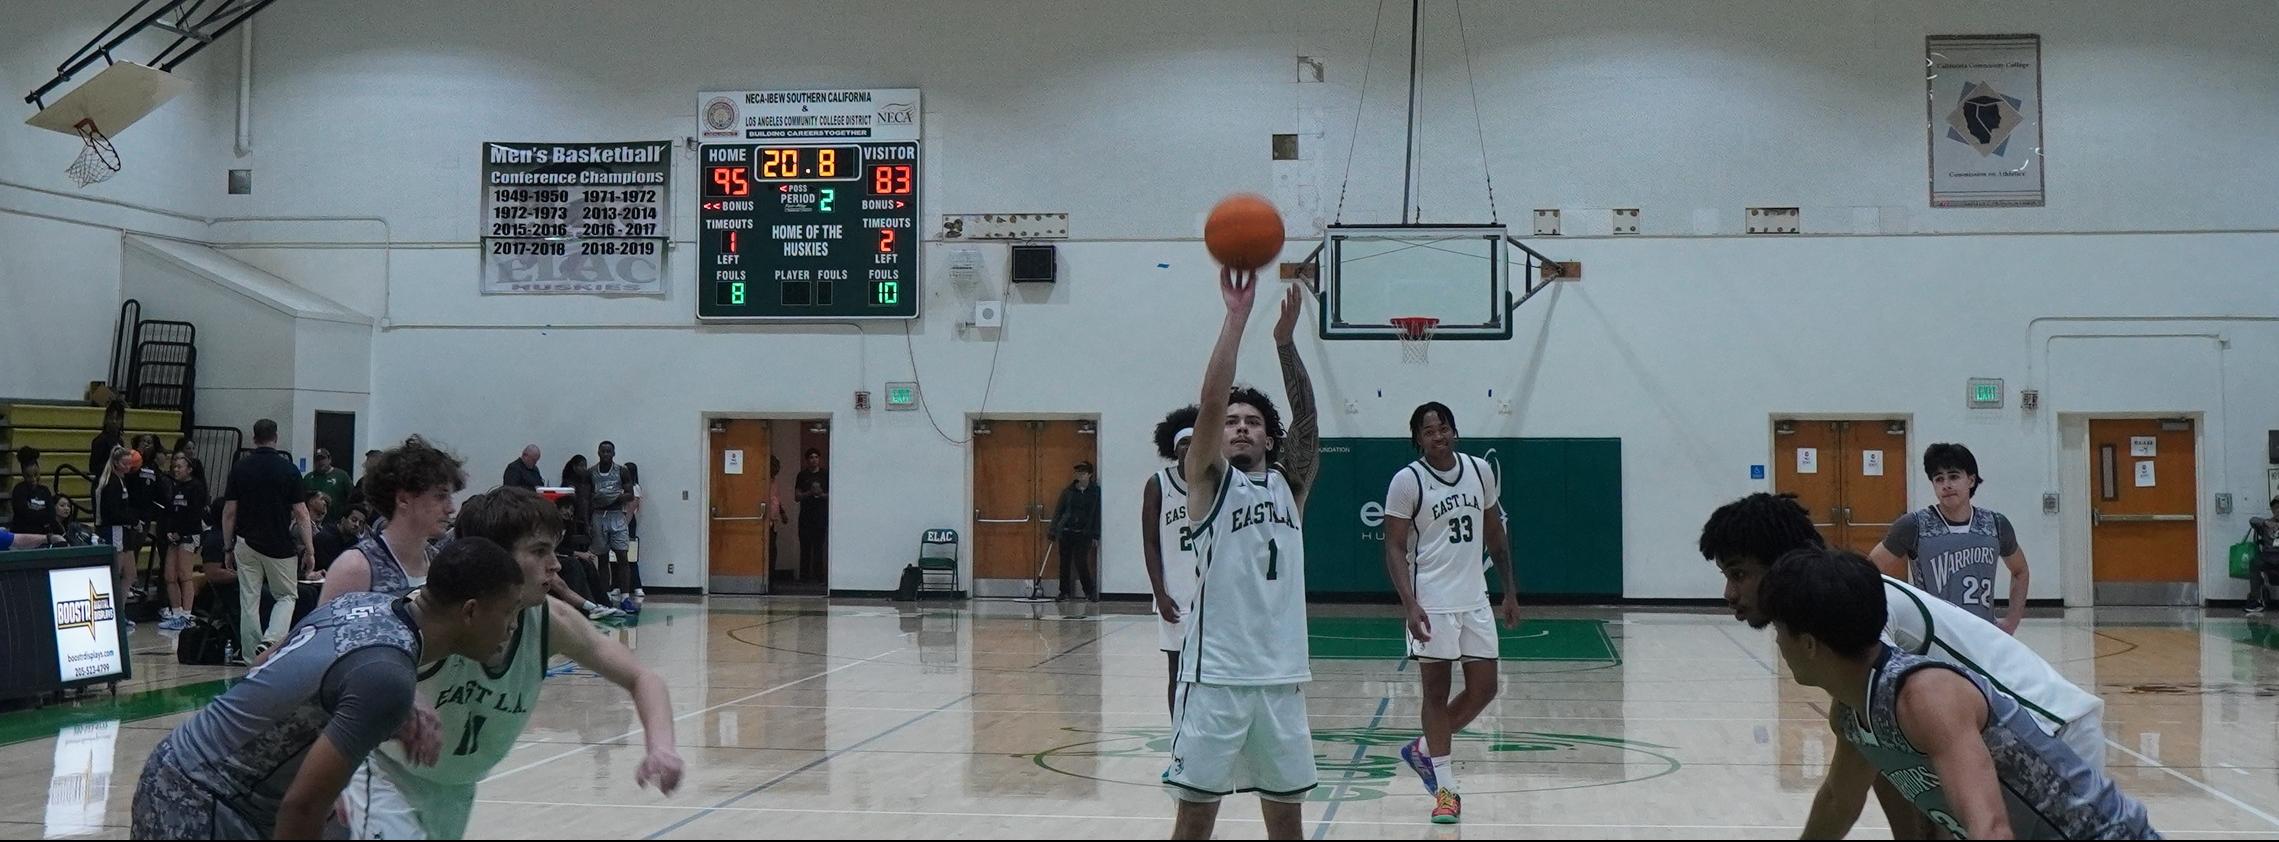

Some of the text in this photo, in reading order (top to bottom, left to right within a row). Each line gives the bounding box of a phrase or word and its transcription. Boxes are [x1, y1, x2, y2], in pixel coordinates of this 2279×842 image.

[745, 91, 872, 104] NECA-IBEW SOUTHERN CALIFORNIA
[745, 115, 872, 127] LOS ANGELES COMMUNITY COLLEGE DISTRICT
[877, 111, 913, 123] NECA
[490, 145, 661, 164] Men's Basketball
[709, 148, 747, 162] HOME
[864, 146, 915, 160] VISITOR
[491, 170, 664, 185] Conference Champions
[714, 167, 748, 195] 95
[875, 165, 911, 194] 83
[788, 184, 808, 193] POSS
[494, 189, 656, 203] 1949-1950 1971-1972
[780, 193, 816, 204] PERIOD
[820, 189, 834, 212] 2
[722, 201, 754, 211] BONUS
[862, 200, 894, 210] BONUS
[494, 206, 657, 220] 1972-1973 2013-2014
[493, 223, 567, 236] 2015-2016
[706, 218, 754, 229] TIMEOUTS
[862, 217, 911, 228] TIMEOUTS
[772, 224, 843, 240] HOME OF THE
[493, 241, 654, 255] 2017-2018 2018-2019
[729, 231, 736, 253] 1
[879, 229, 894, 253] 2
[783, 242, 829, 256] HUSKIES
[717, 254, 740, 265] LEFT
[875, 253, 898, 264] LEFT
[716, 270, 747, 280] FOULS
[775, 269, 848, 280] PLAYER FOULS
[869, 269, 899, 280] FOULS
[511, 283, 641, 291] HUSKIES
[731, 282, 745, 304] 8
[878, 281, 897, 304] 10
[1432, 493, 1461, 520] EAST
[1165, 505, 1187, 526] EAS
[1231, 501, 1275, 533] EAST
[927, 531, 953, 542] ELAC
[1449, 515, 1474, 544] 33
[1266, 538, 1279, 581] 1
[1961, 575, 1992, 609] 22
